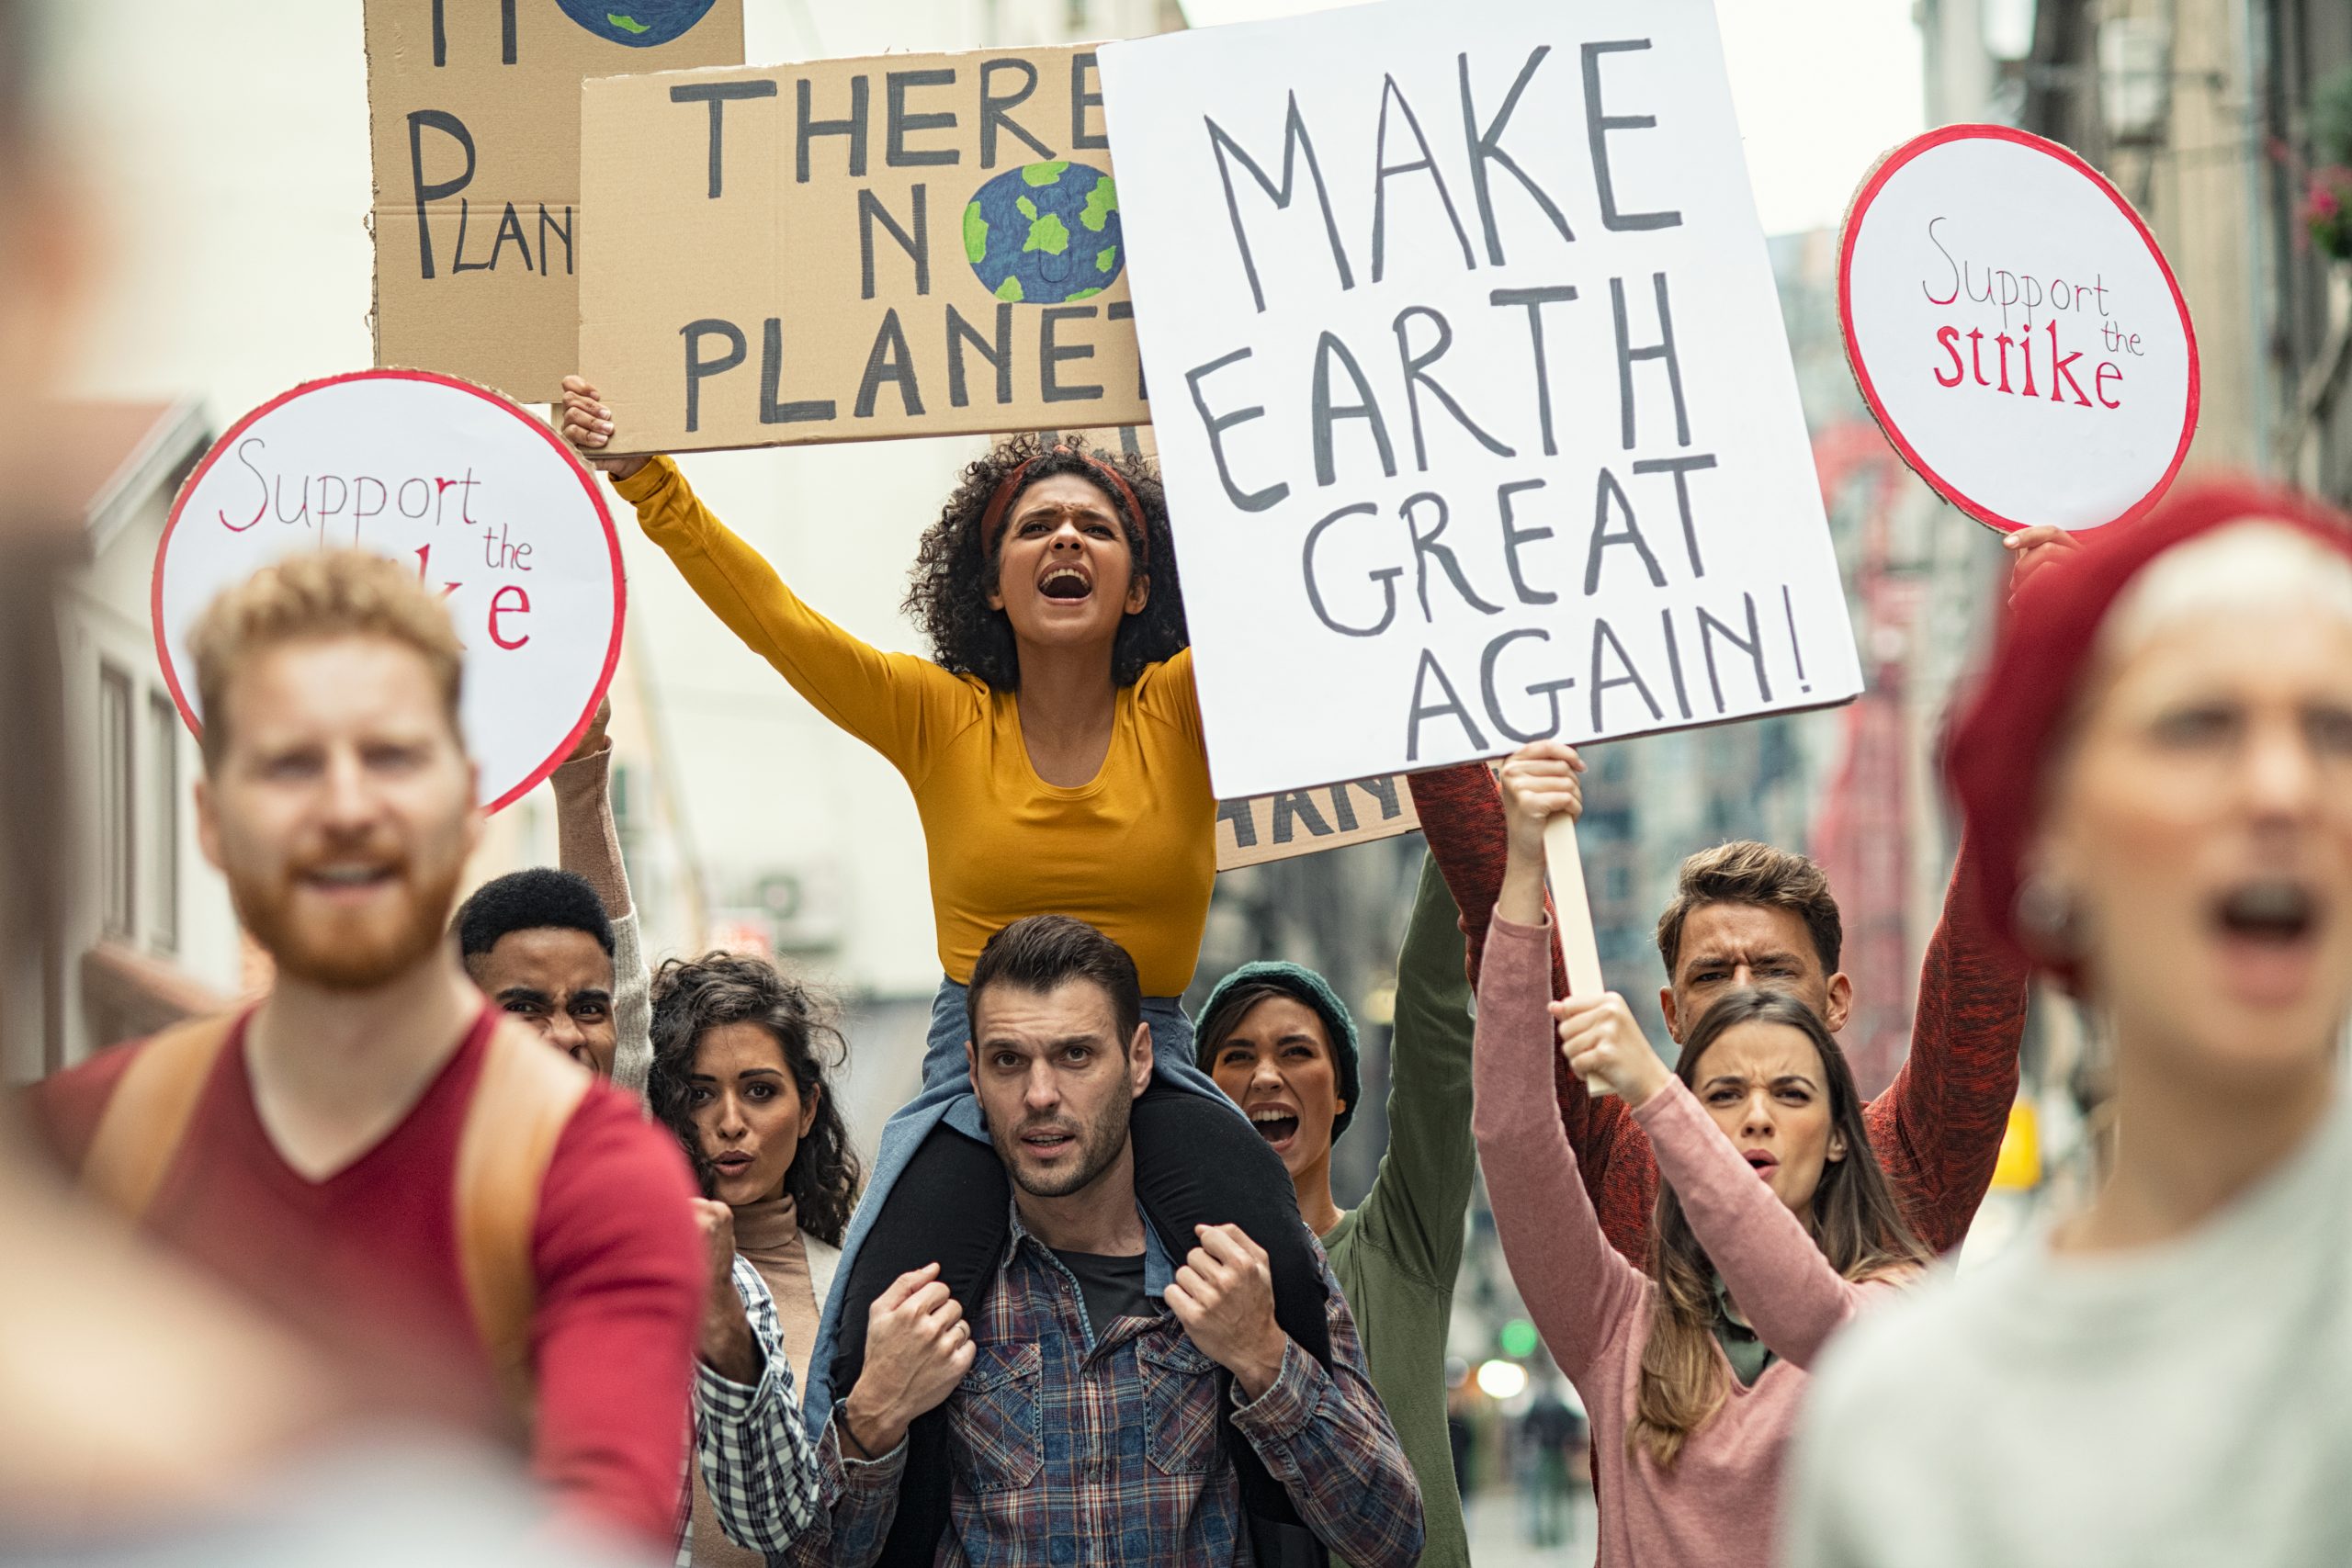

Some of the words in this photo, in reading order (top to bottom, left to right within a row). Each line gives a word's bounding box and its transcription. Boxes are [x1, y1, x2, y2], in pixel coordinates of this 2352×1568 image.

[670, 52, 1110, 198] THERE
[1204, 39, 1682, 313] MAKE
[1923, 217, 2109, 329] Support
[1185, 272, 1691, 513] EARTH
[1933, 319, 2123, 409] strike
[2101, 321, 2144, 355] the
[219, 438, 481, 551] Support
[482, 523, 533, 571] the
[1302, 454, 1717, 637] GREAT
[1407, 585, 1813, 761] AGAIN!
